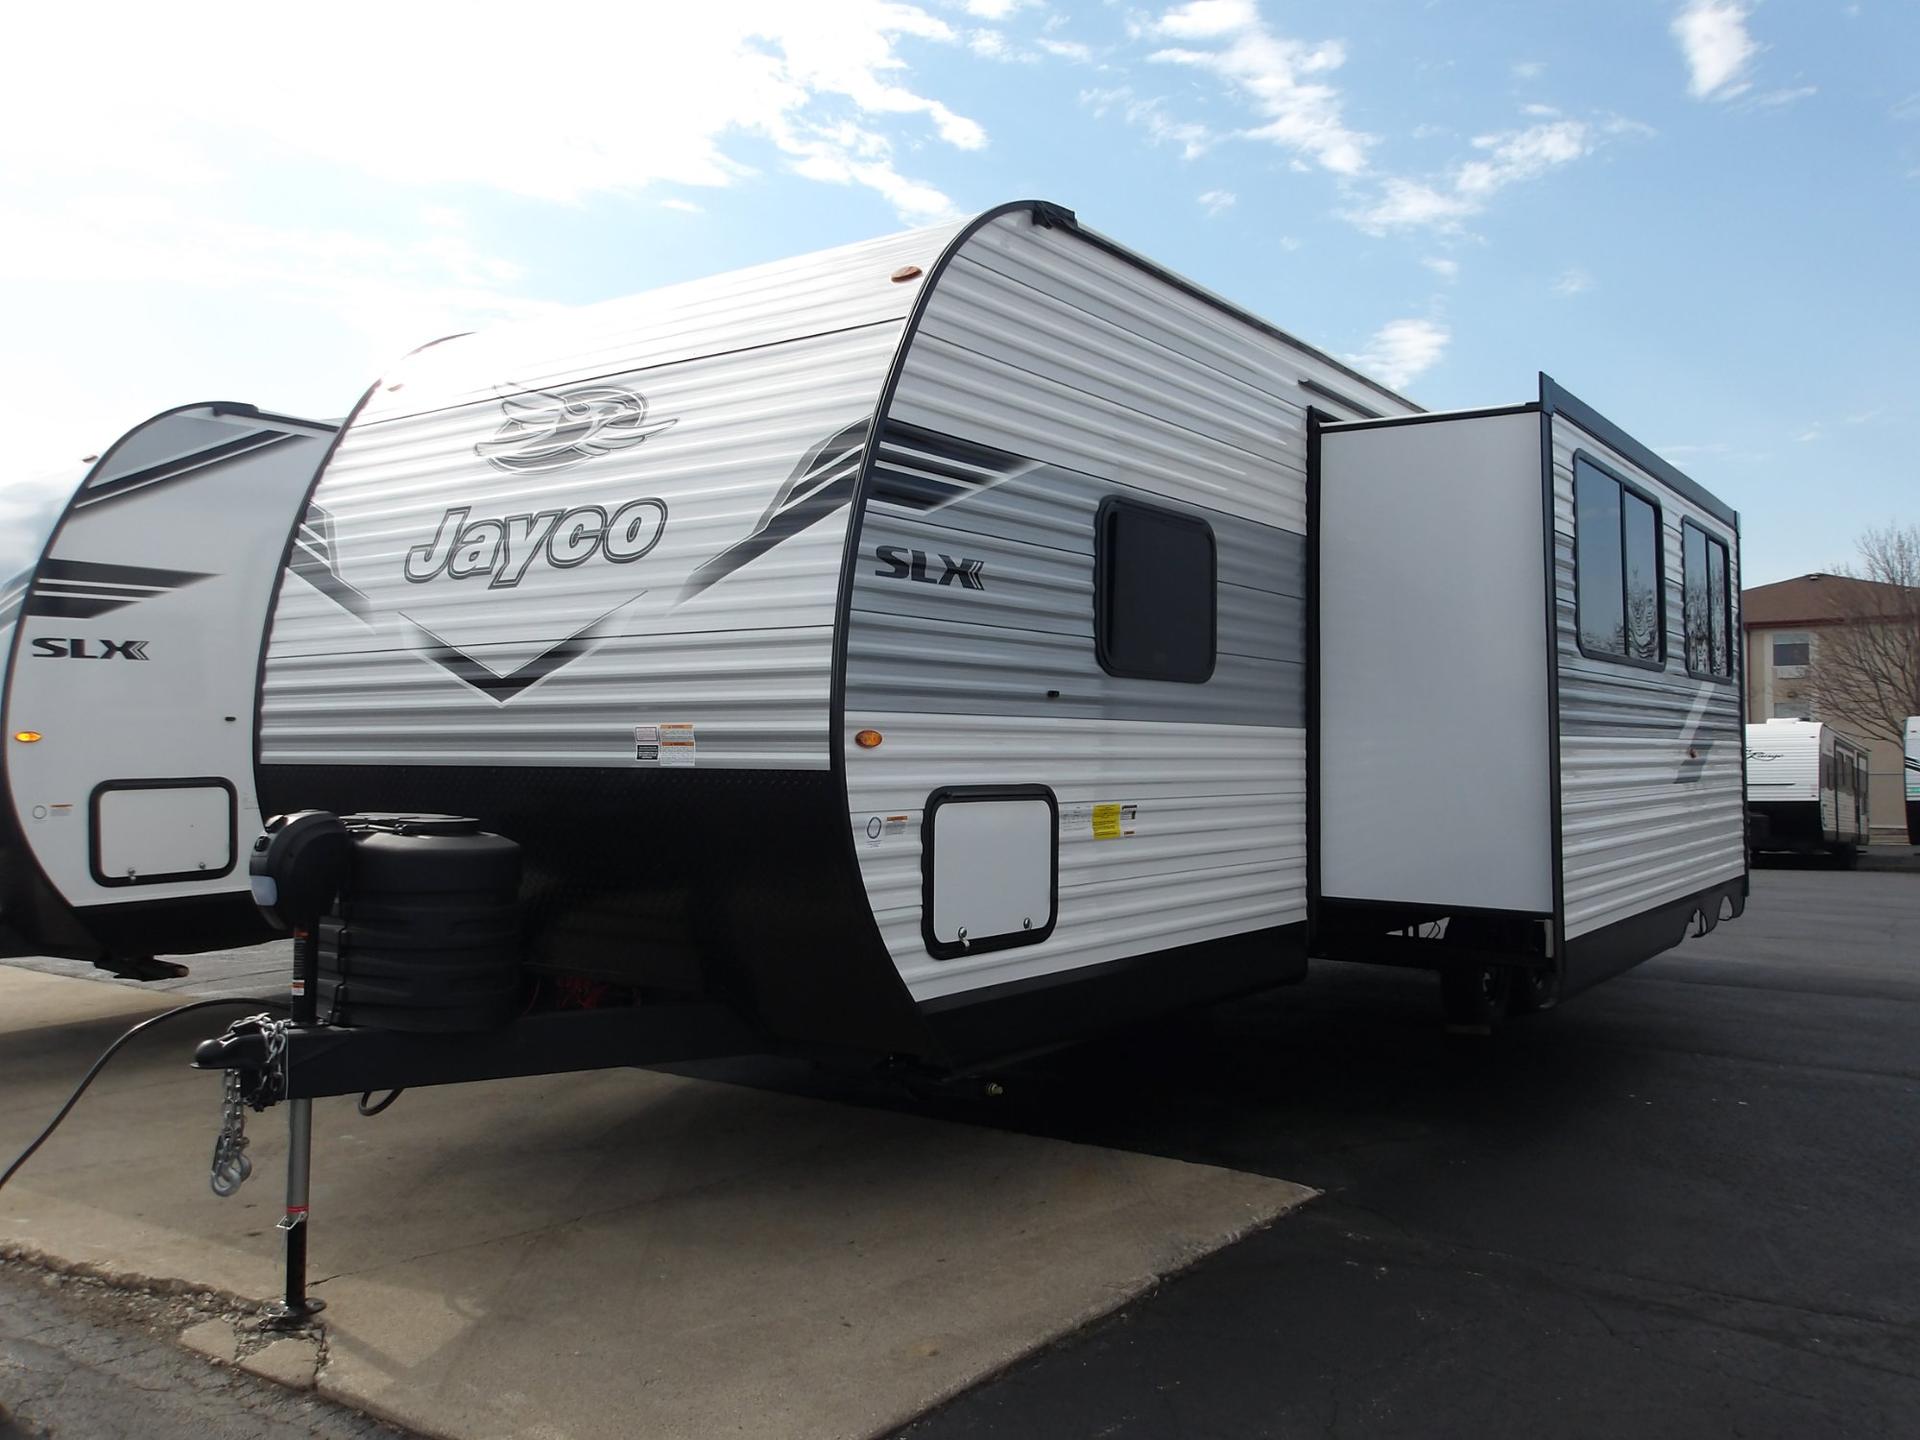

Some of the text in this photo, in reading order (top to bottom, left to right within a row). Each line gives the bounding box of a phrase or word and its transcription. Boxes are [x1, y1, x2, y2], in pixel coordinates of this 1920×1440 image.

[404, 497, 669, 590] Jayco
[875, 545, 985, 591] SLX
[32, 637, 150, 661] SLX
